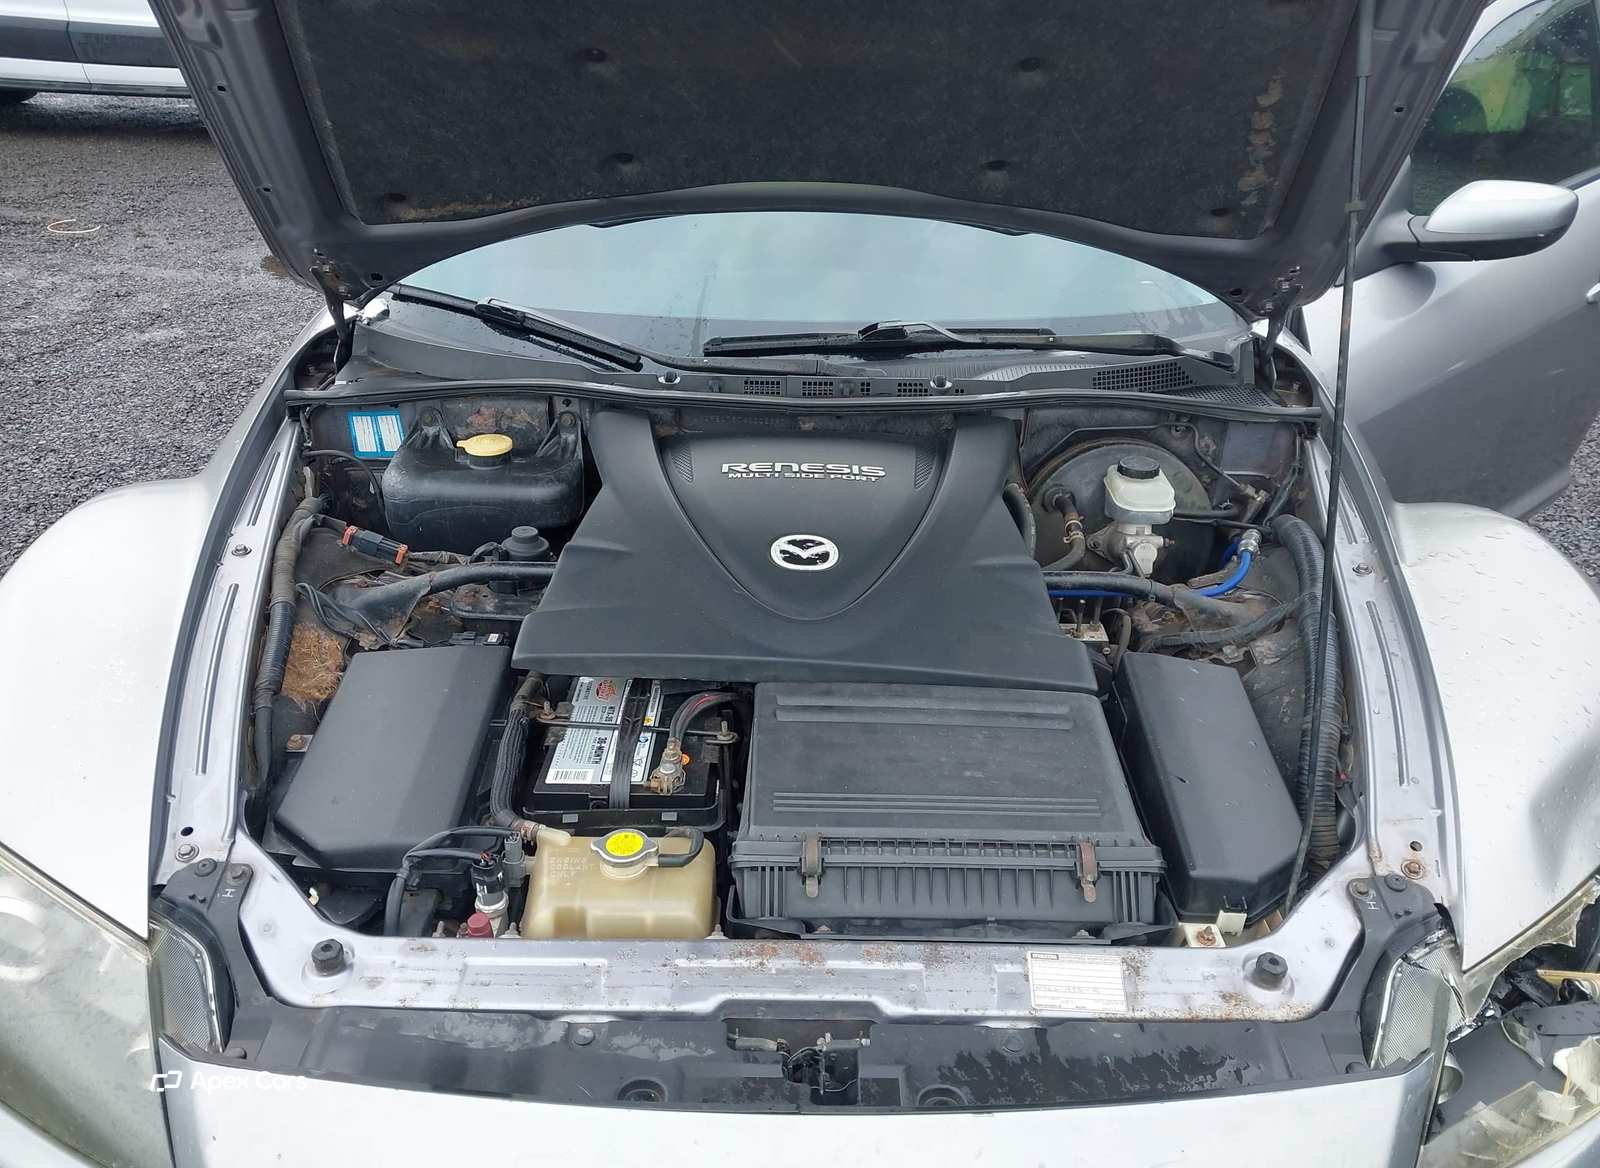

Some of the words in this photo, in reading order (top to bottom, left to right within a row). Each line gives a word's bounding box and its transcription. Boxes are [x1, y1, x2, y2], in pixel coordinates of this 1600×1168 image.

[721, 462, 887, 477] RENESIS
[830, 474, 879, 482] PORT
[591, 736, 607, 764] 36-MONTH
[549, 863, 596, 871] COOLANT
